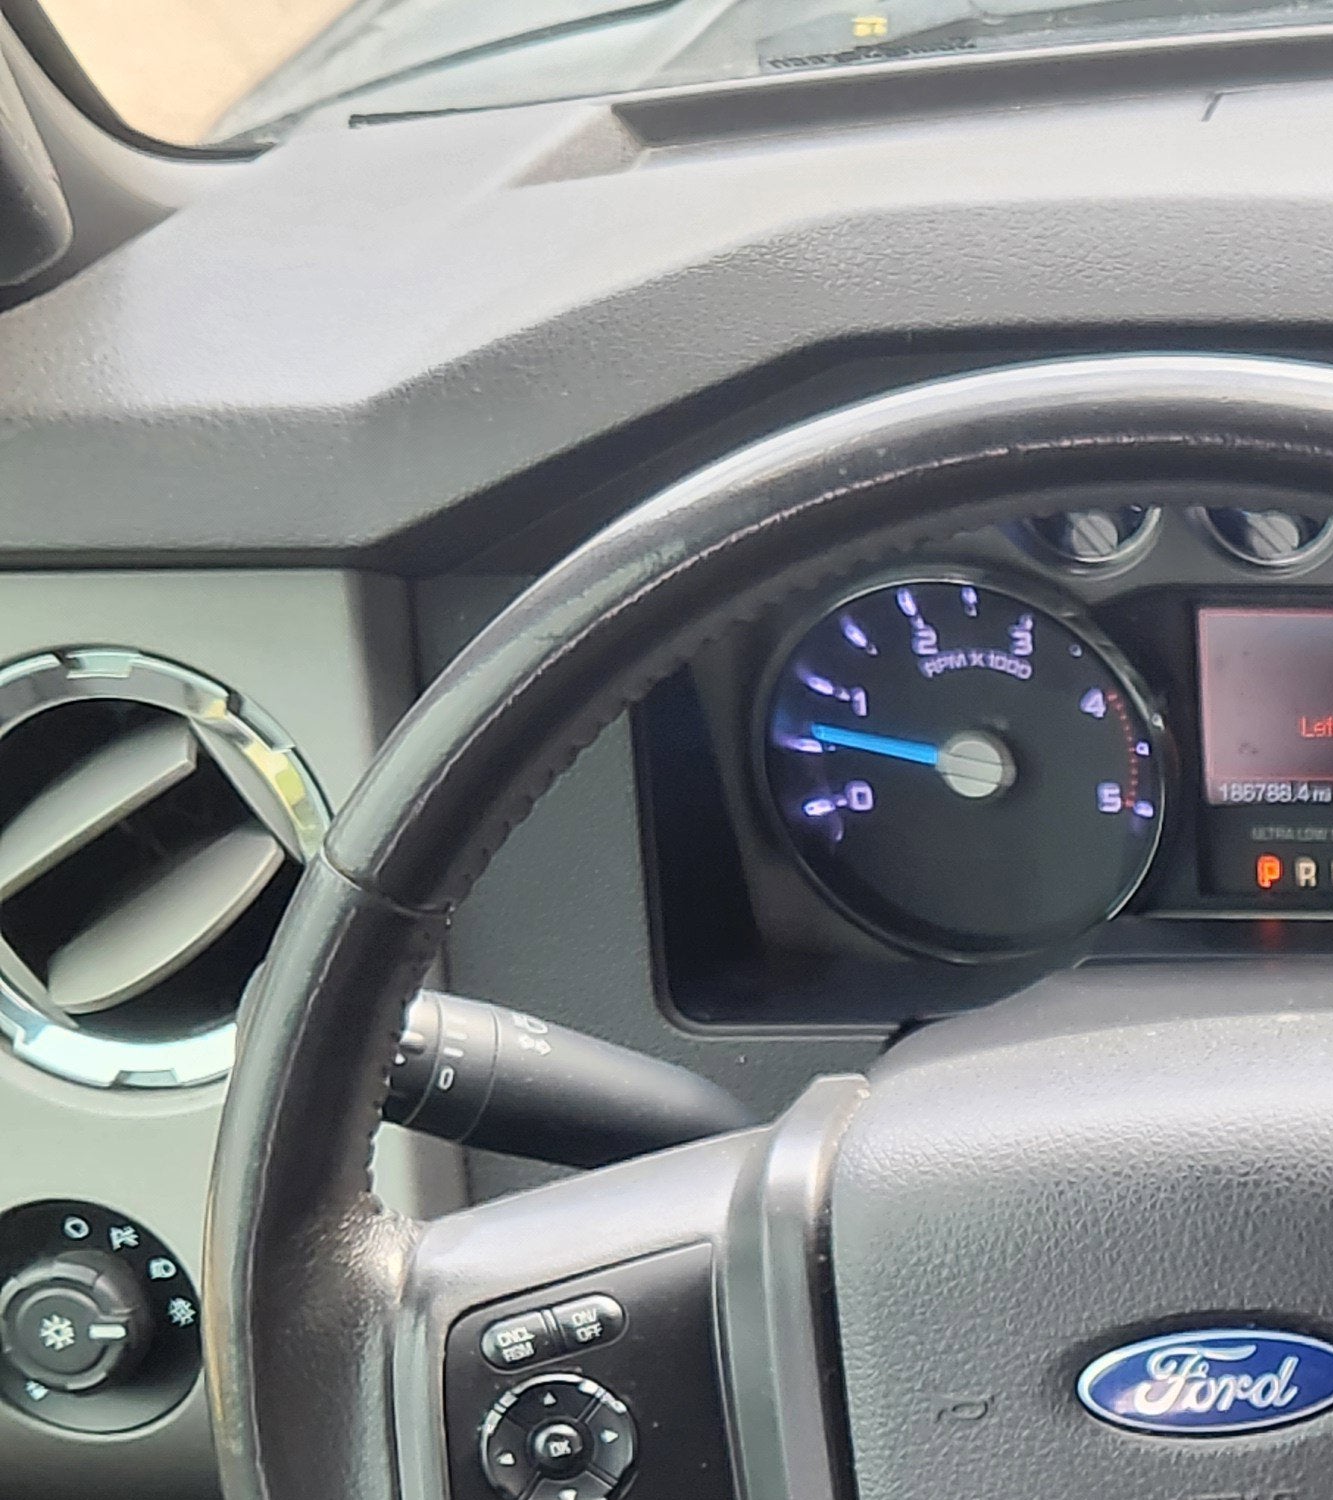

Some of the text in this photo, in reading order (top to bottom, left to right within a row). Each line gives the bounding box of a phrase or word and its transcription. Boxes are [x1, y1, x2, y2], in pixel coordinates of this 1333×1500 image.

[913, 625, 938, 655] 2
[1009, 627, 1033, 655] 3
[923, 652, 967, 678] RPM
[987, 652, 1032, 680] 1000
[851, 688, 868, 716] 1
[1081, 689, 1106, 717] 4
[845, 781, 873, 811] 0
[1099, 782, 1121, 813] 5
[1257, 855, 1282, 888] P
[1295, 858, 1318, 888] R
[498, 1326, 535, 1346] CNCL
[576, 1323, 603, 1342] OFF
[1134, 1344, 1298, 1415] Ford
[549, 1440, 572, 1457] OK
